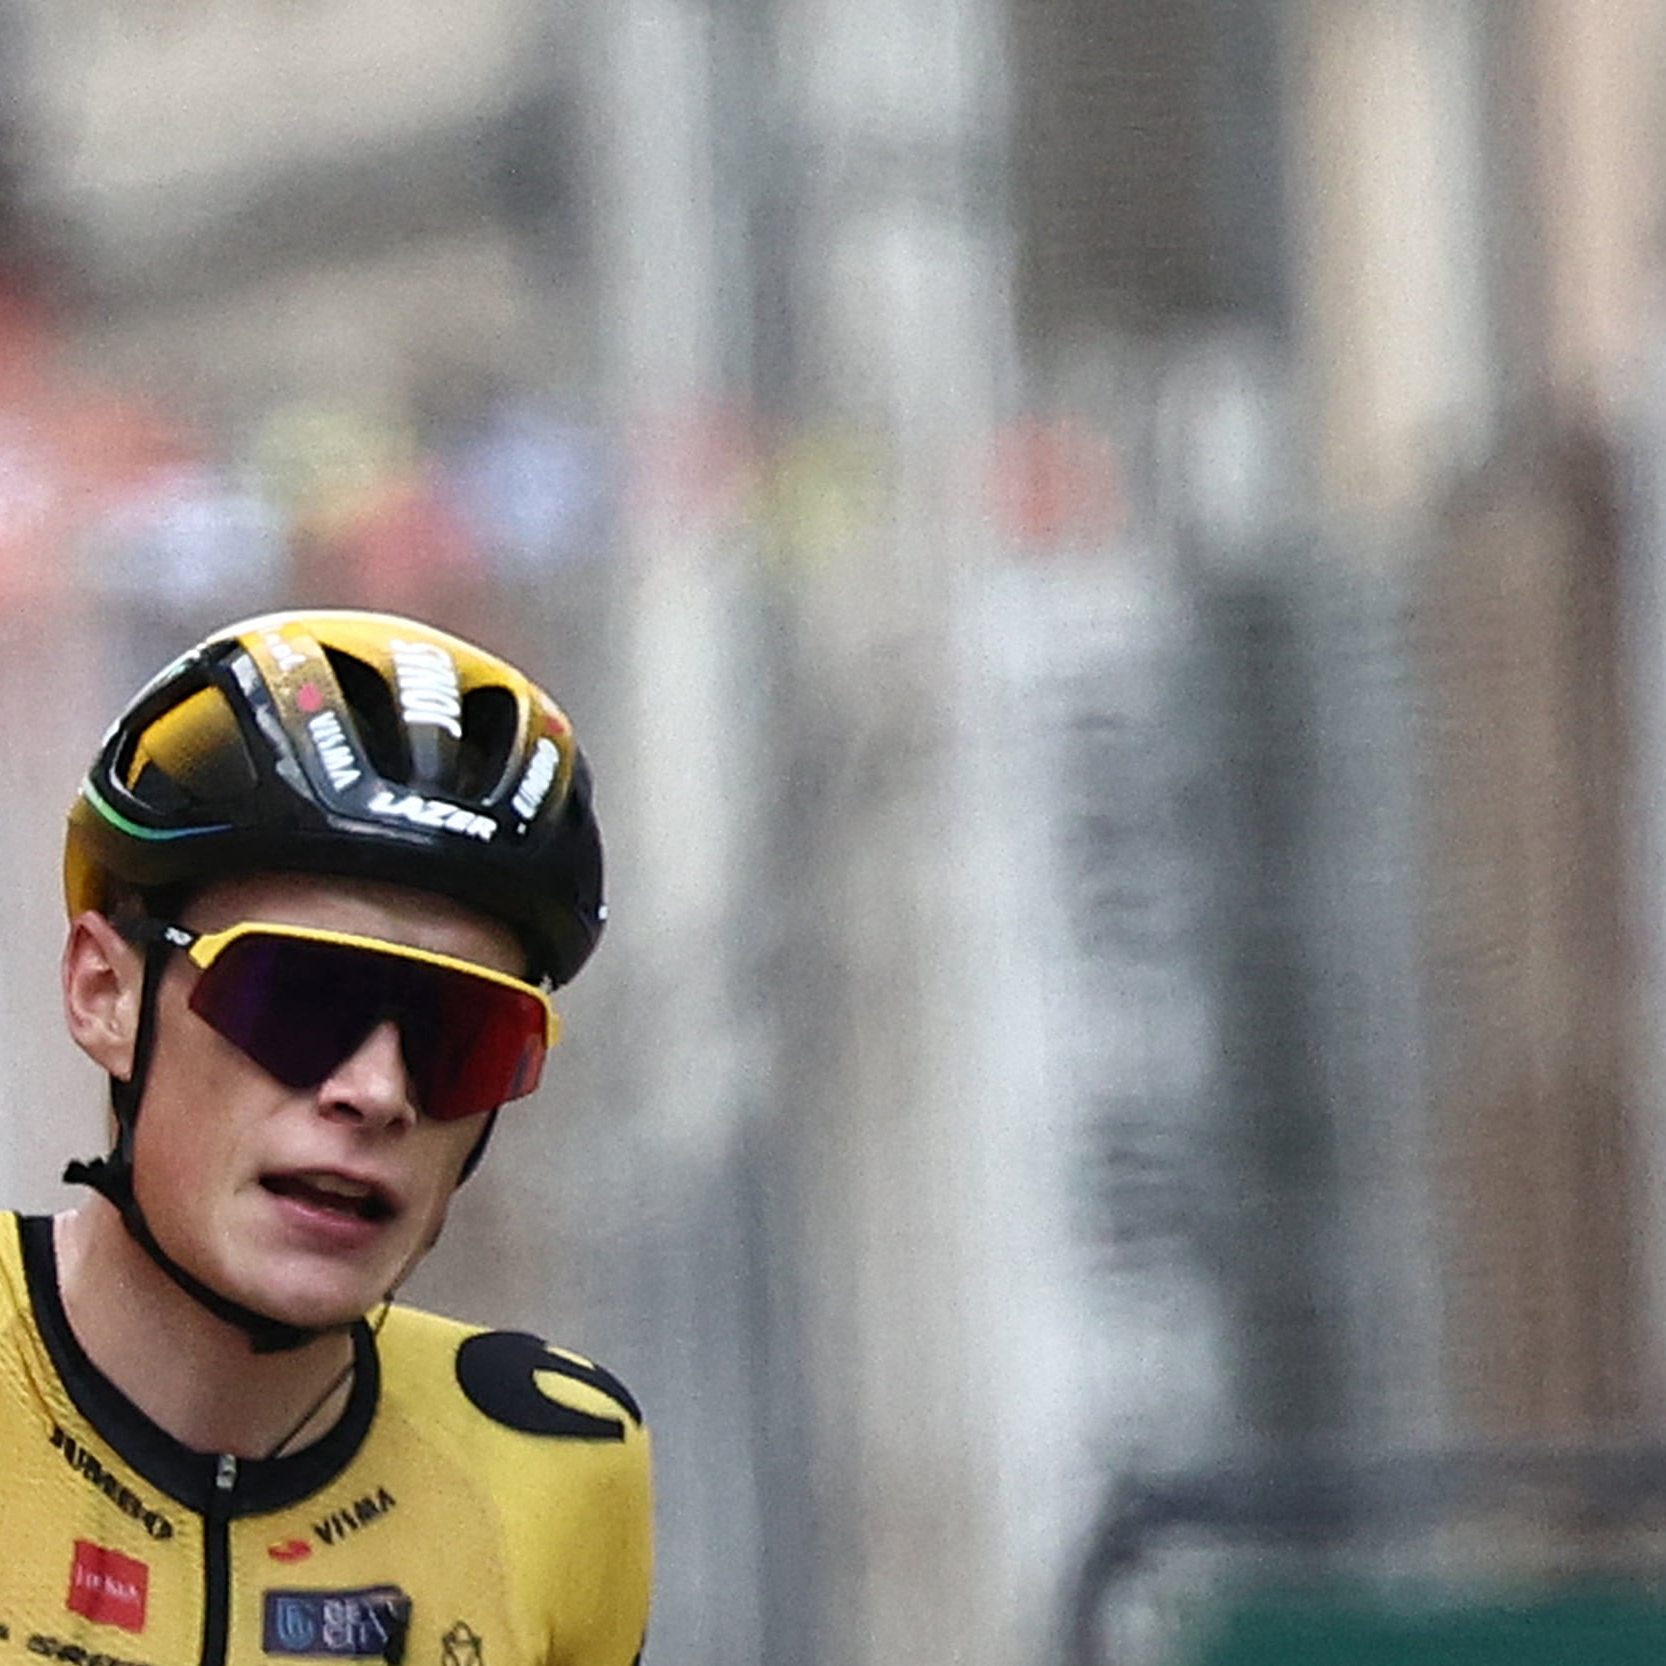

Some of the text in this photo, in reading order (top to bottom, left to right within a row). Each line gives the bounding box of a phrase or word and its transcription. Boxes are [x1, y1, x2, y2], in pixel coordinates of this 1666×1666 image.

[366, 790, 499, 843] LAZER
[48, 1423, 174, 1540] JUMBO
[313, 1484, 397, 1546] VISMA
